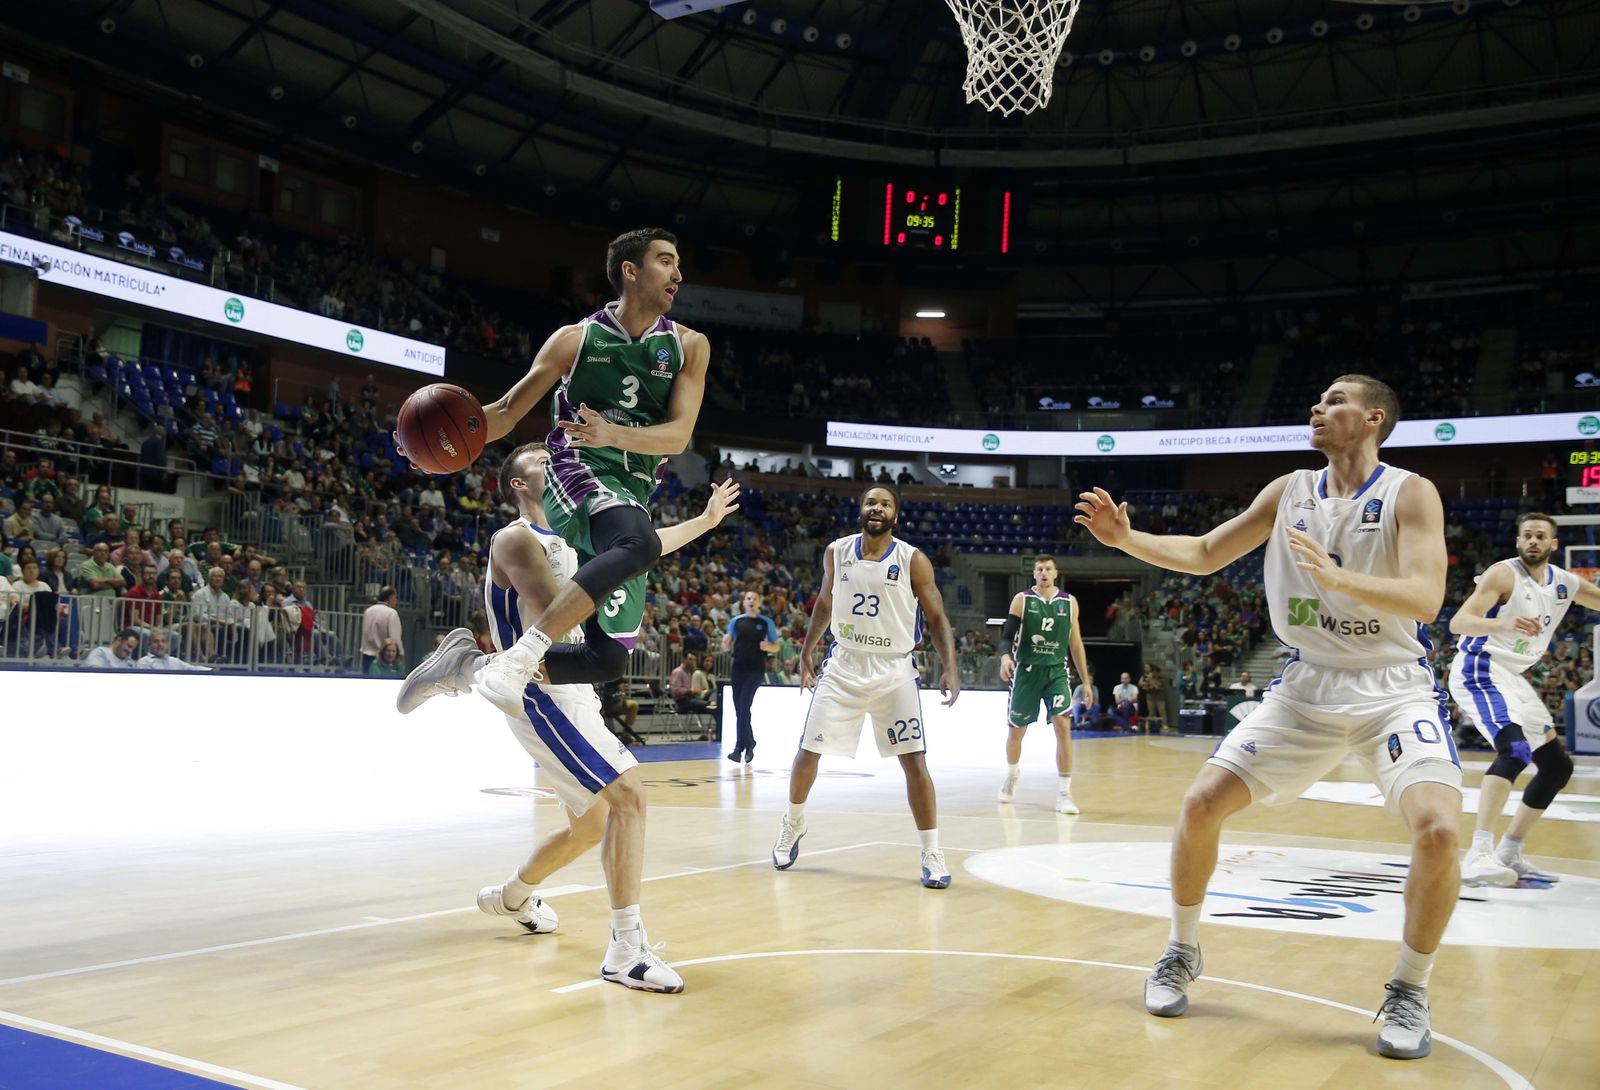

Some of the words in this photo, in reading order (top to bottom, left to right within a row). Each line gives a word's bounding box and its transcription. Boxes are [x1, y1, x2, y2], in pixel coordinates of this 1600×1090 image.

[906, 215, 935, 228] 09:35
[404, 348, 444, 366] ANTICIPO
[618, 375, 640, 409] 3
[1158, 437, 1204, 446] ANTICIPO
[1205, 436, 1232, 445] BECA
[604, 589, 627, 618] 3
[852, 592, 880, 617] 23
[1041, 616, 1055, 632] 12
[1052, 694, 1065, 708] 12
[894, 717, 922, 742] 23
[1412, 719, 1441, 744] 0
